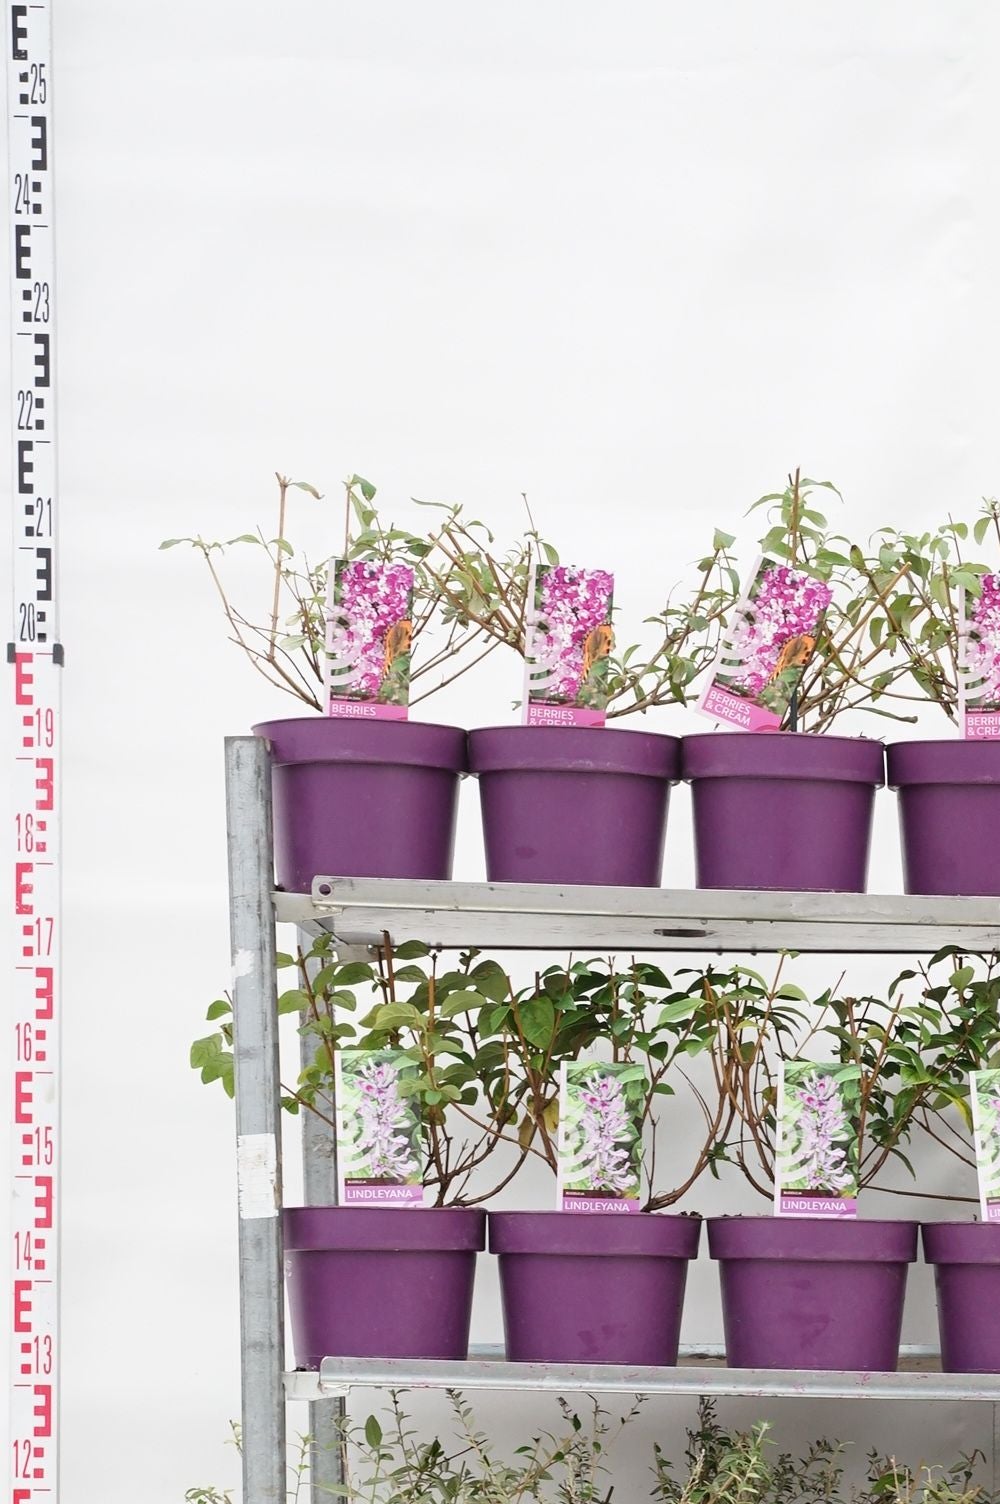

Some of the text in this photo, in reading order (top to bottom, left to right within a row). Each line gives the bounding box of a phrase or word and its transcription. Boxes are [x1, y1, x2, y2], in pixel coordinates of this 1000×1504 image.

[30, 63, 47, 105] 25
[14, 172, 31, 215] 24
[33, 281, 50, 323] 23
[17, 389, 34, 431] 22
[35, 496, 52, 537] 21
[19, 602, 36, 642] 20
[331, 702, 377, 717] BERRIES
[530, 707, 574, 720] BERRIES
[709, 690, 751, 714] BERRIES
[714, 704, 751, 726] CREAM
[34, 707, 54, 748] 19
[15, 813, 34, 853] 18
[35, 916, 55, 956] 17
[15, 1022, 33, 1062] 16
[34, 1125, 54, 1165] 15
[346, 1186, 414, 1201] LINDLEYANA
[564, 1200, 631, 1213] LINDLEYANA
[782, 1200, 847, 1211] LINDLEYANA
[14, 1230, 32, 1271] 14
[33, 1334, 52, 1375] 13
[12, 1438, 31, 1479] 12
